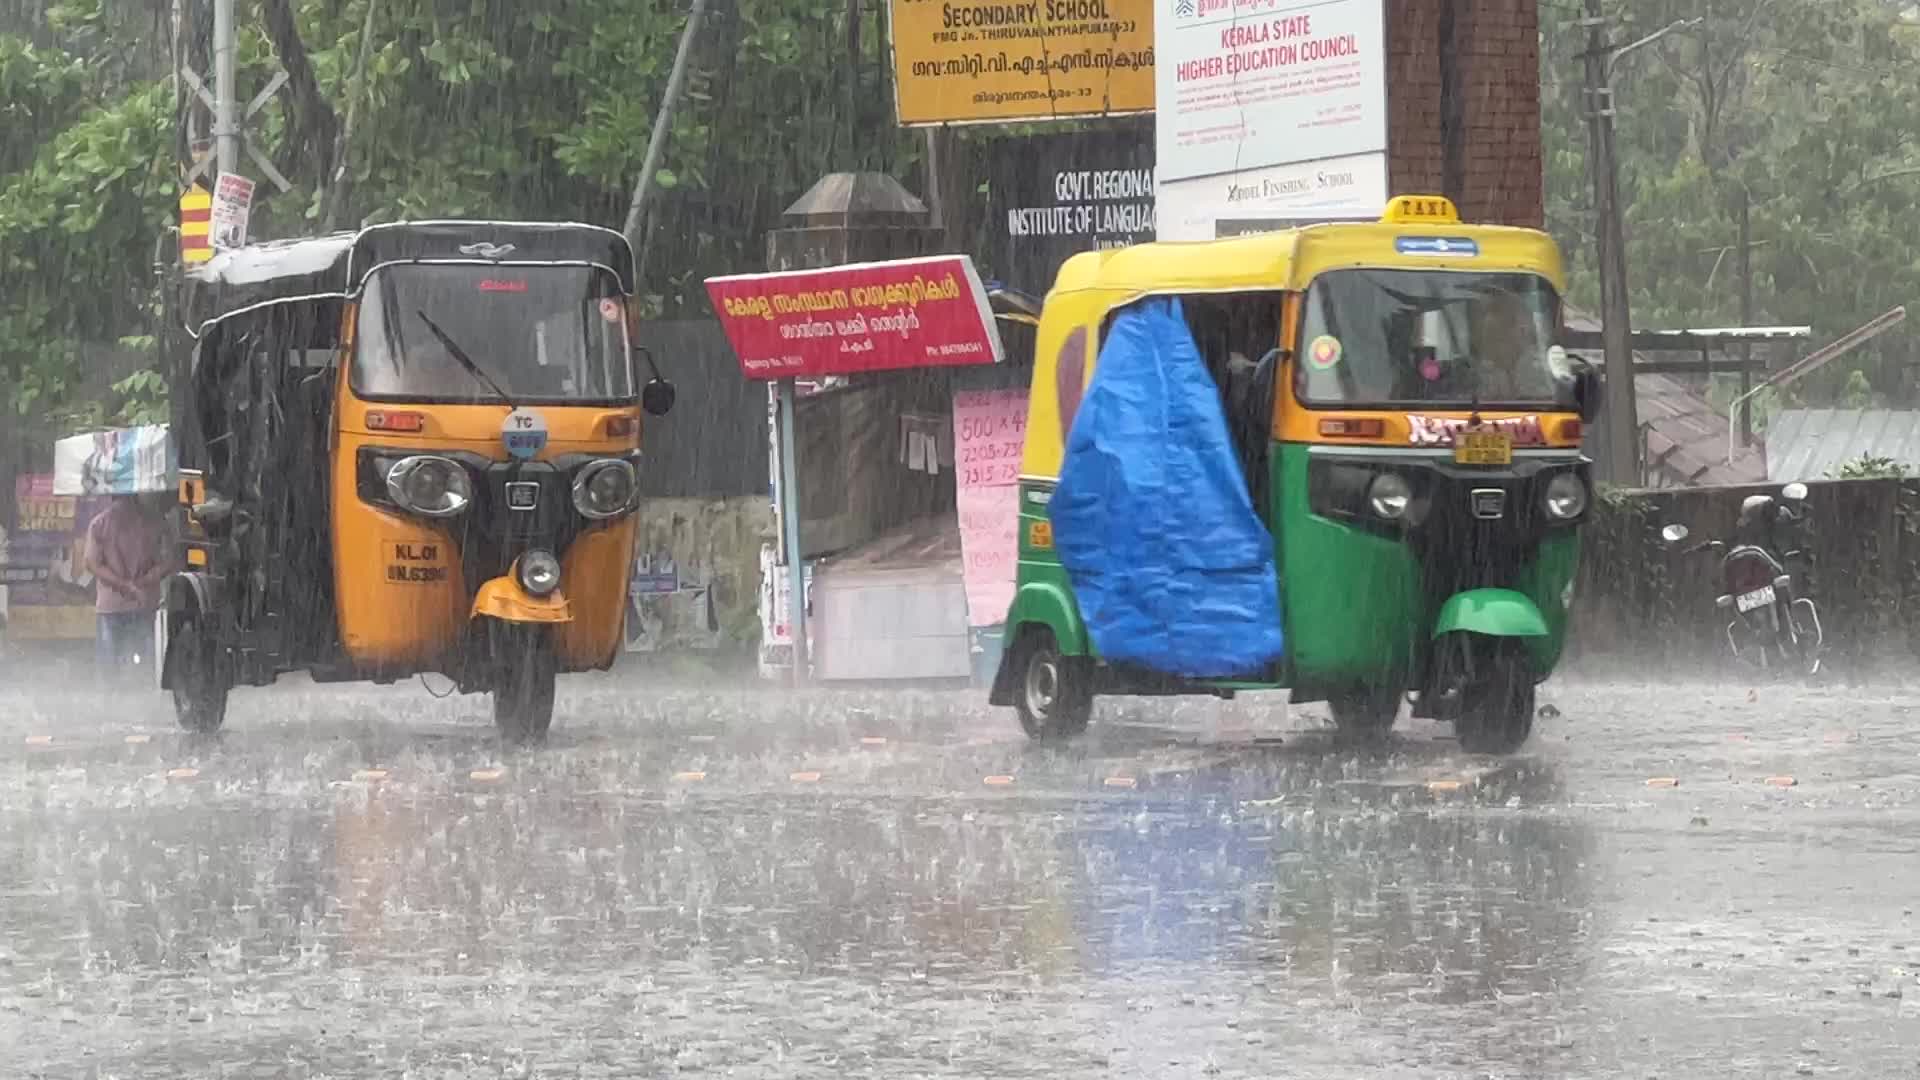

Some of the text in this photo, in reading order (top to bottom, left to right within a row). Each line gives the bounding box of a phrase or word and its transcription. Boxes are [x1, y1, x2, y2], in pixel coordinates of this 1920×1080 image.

[1046, 0, 1109, 20] SCHOOL
[1221, 15, 1311, 49] KERALA STATE
[1177, 34, 1359, 82] HIGHER EDUCATION COUNCIL
[1008, 206, 1073, 235] INSTITUTE
[1075, 206, 1093, 233] OF
[1402, 200, 1447, 216] TAXI
[724, 295, 774, 320] കേരള
[515, 415, 532, 428] TC
